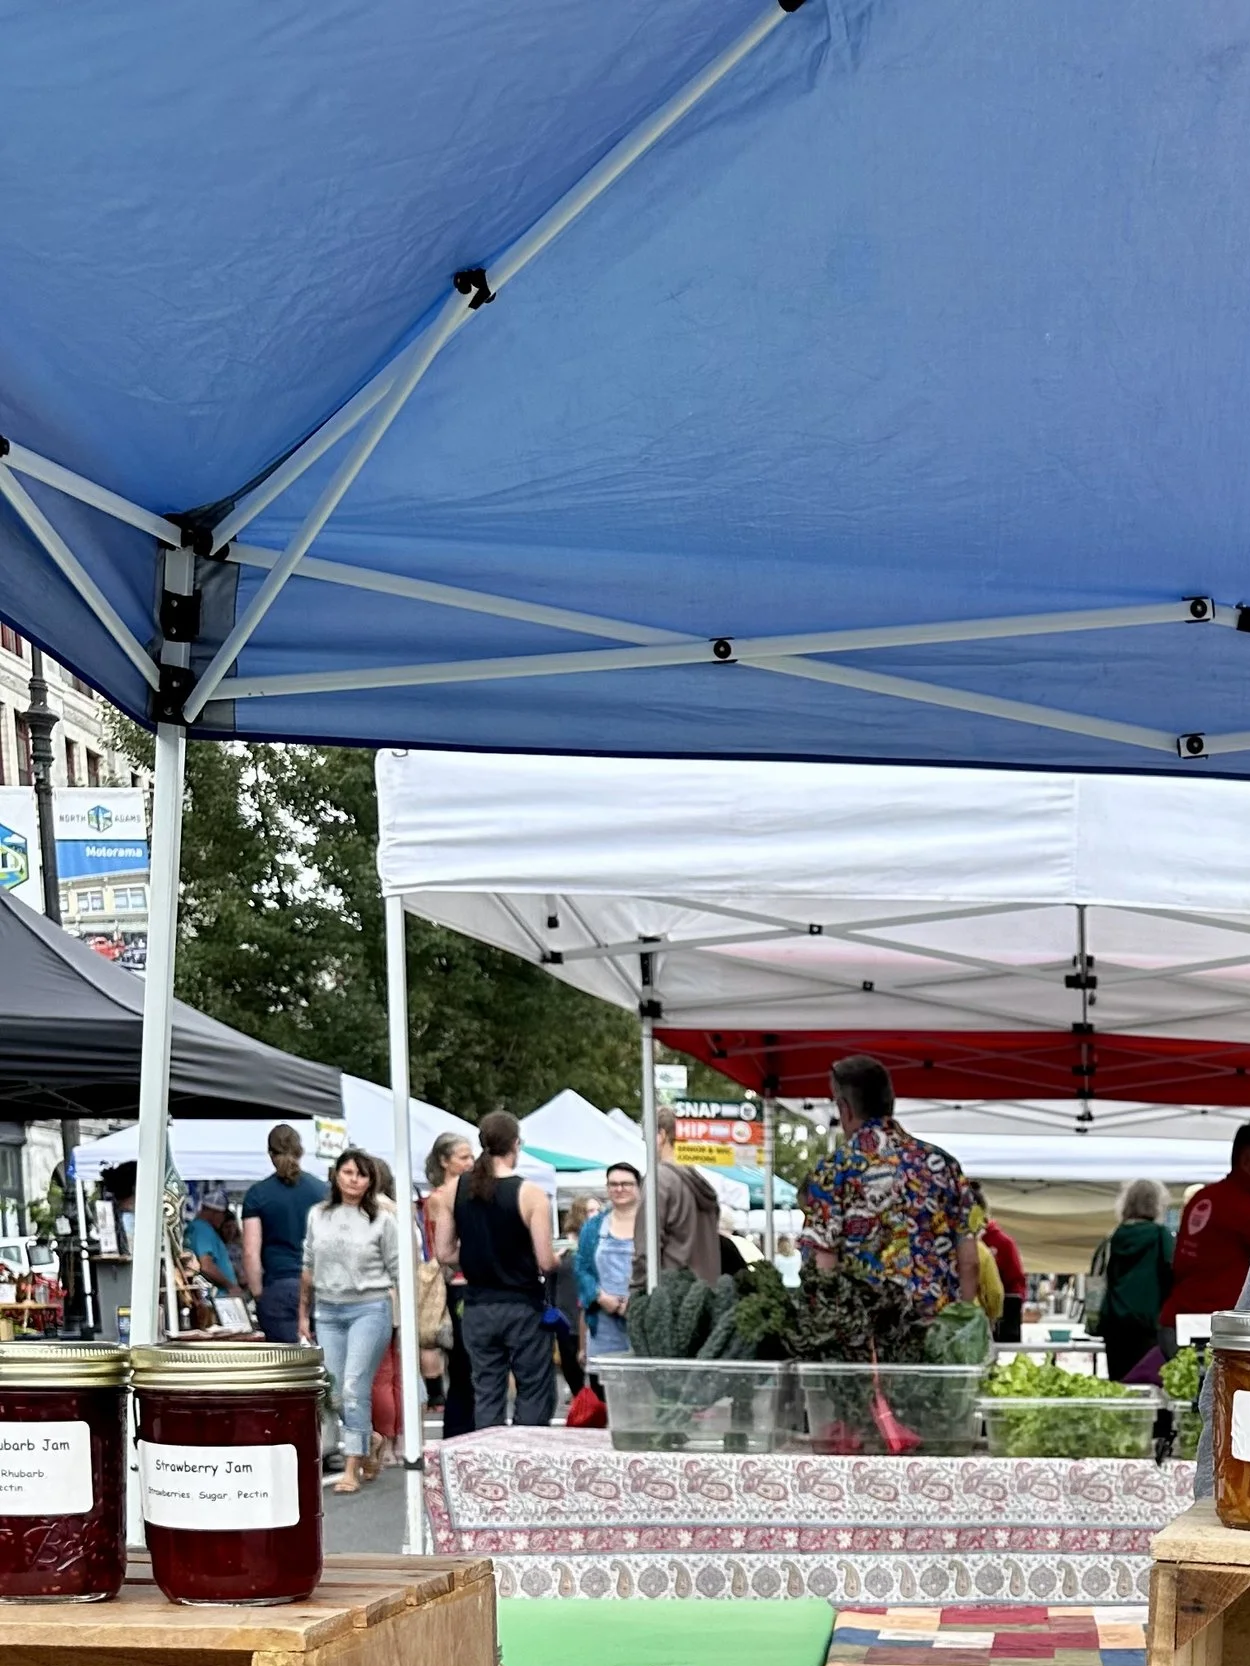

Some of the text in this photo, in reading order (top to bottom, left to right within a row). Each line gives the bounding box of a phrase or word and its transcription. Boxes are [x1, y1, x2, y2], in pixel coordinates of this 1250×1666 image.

[85, 846, 143, 858] Motorama
[675, 1101, 721, 1118] SNAP
[676, 1121, 709, 1139] HIP
[42, 1438, 70, 1452] Jam
[155, 1459, 253, 1477] Strawberry Jam
[237, 1490, 269, 1499] Pectin
